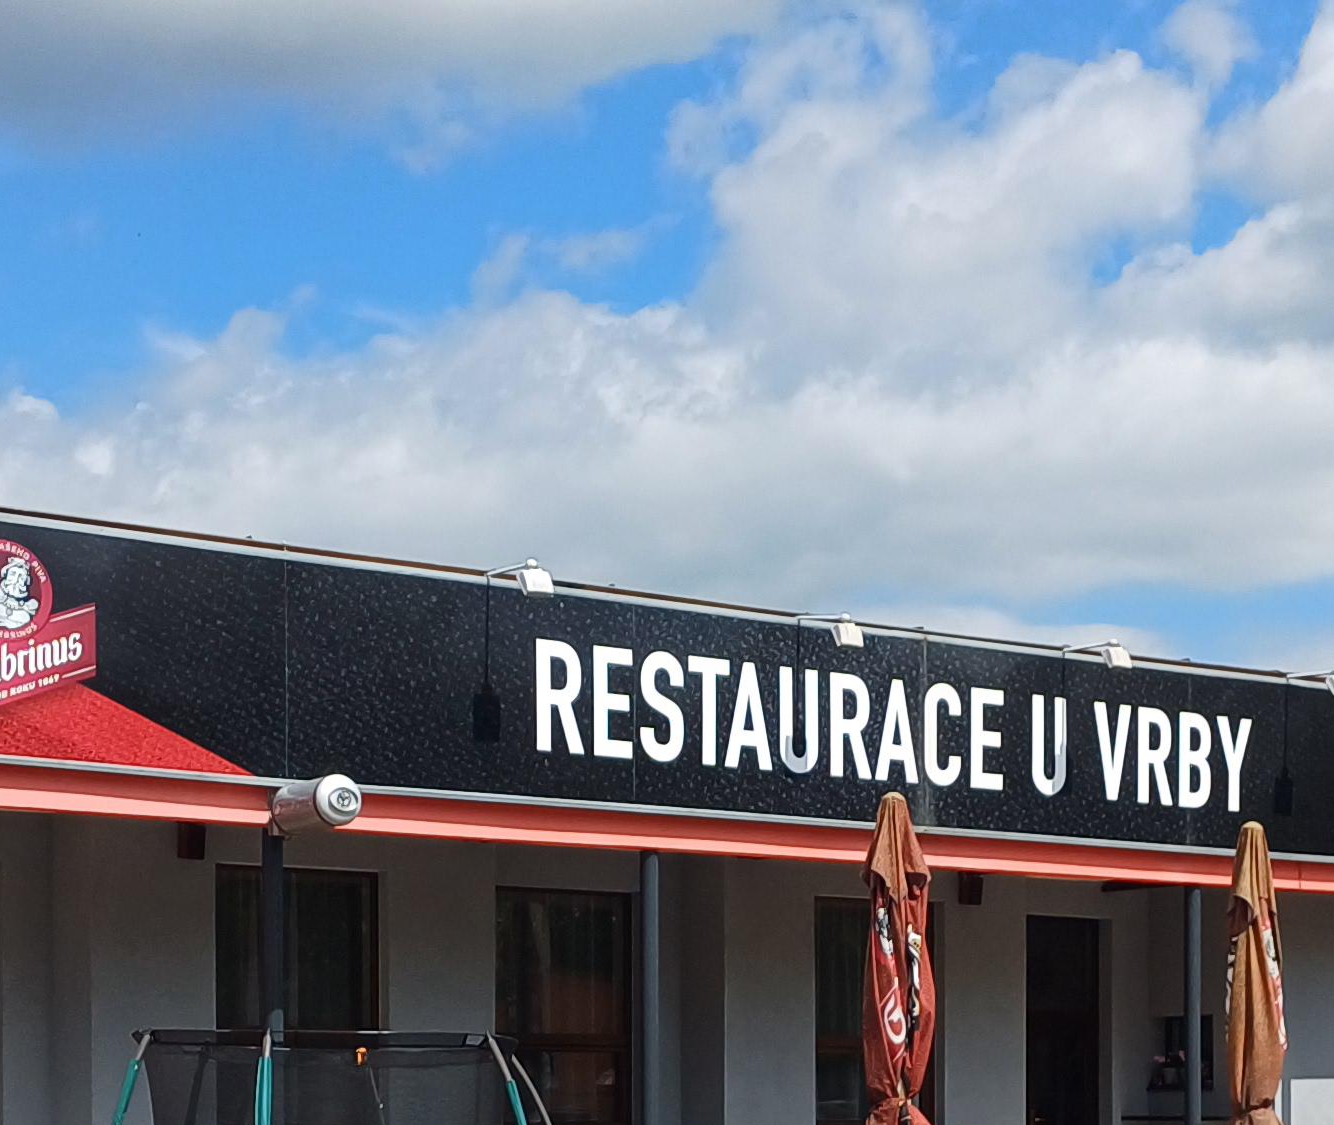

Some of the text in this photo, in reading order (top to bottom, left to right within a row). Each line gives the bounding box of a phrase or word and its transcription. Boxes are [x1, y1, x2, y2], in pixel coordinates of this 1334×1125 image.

[31, 560, 47, 584] PIVA
[10, 681, 36, 697] ROKU
[534, 637, 1253, 813] RESTAURACE U VRBY
